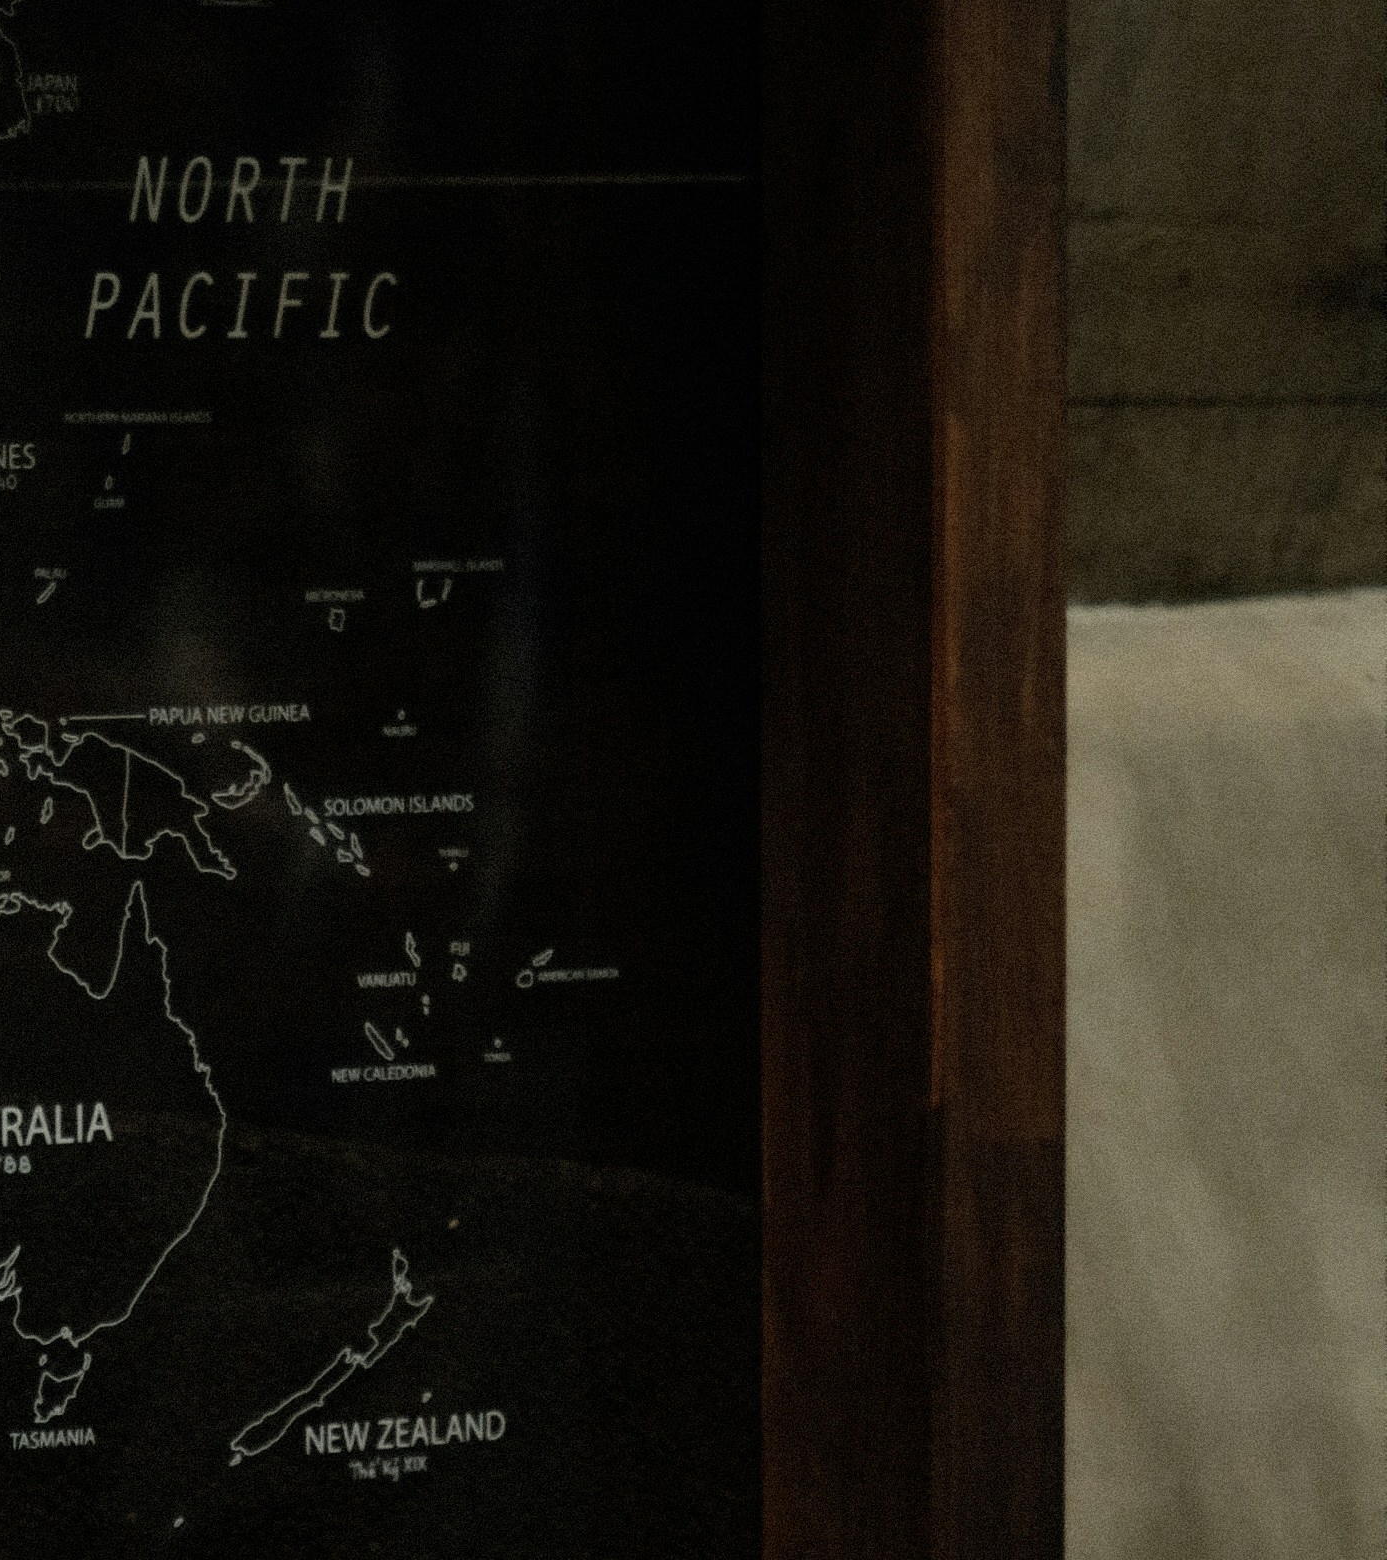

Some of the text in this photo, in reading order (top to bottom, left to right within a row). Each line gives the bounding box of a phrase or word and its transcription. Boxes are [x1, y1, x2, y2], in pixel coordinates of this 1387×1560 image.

[27, 73, 79, 92] JAPAN
[128, 154, 355, 223] NORTH
[83, 272, 400, 340] PACIFIC
[148, 702, 312, 727] PAPUA NEW GUINEA
[322, 792, 475, 818] SOLOMON ISLANDS
[330, 1066, 362, 1084] NEW
[9, 1425, 96, 1451] TASMANIA
[303, 1409, 508, 1455] NEW ZEALAND
